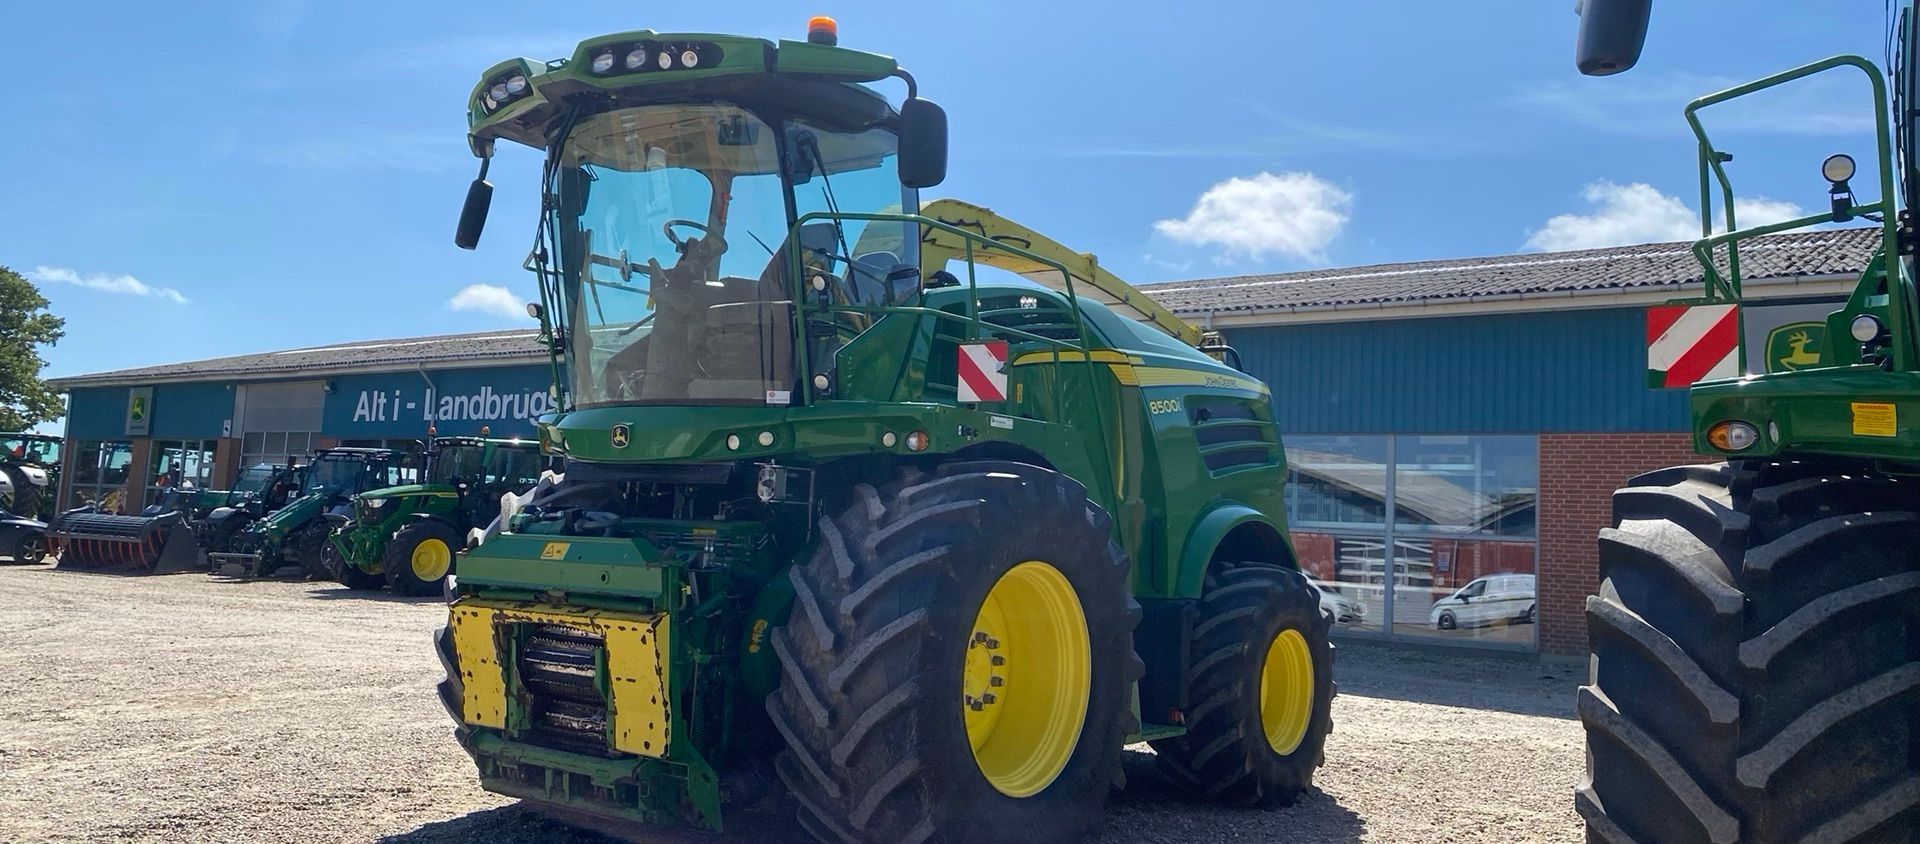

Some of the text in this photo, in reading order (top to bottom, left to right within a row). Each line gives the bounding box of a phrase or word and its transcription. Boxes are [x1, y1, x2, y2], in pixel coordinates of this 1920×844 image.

[353, 390, 387, 422] Alt
[393, 390, 400, 421] i
[1149, 396, 1182, 415] 8500i
